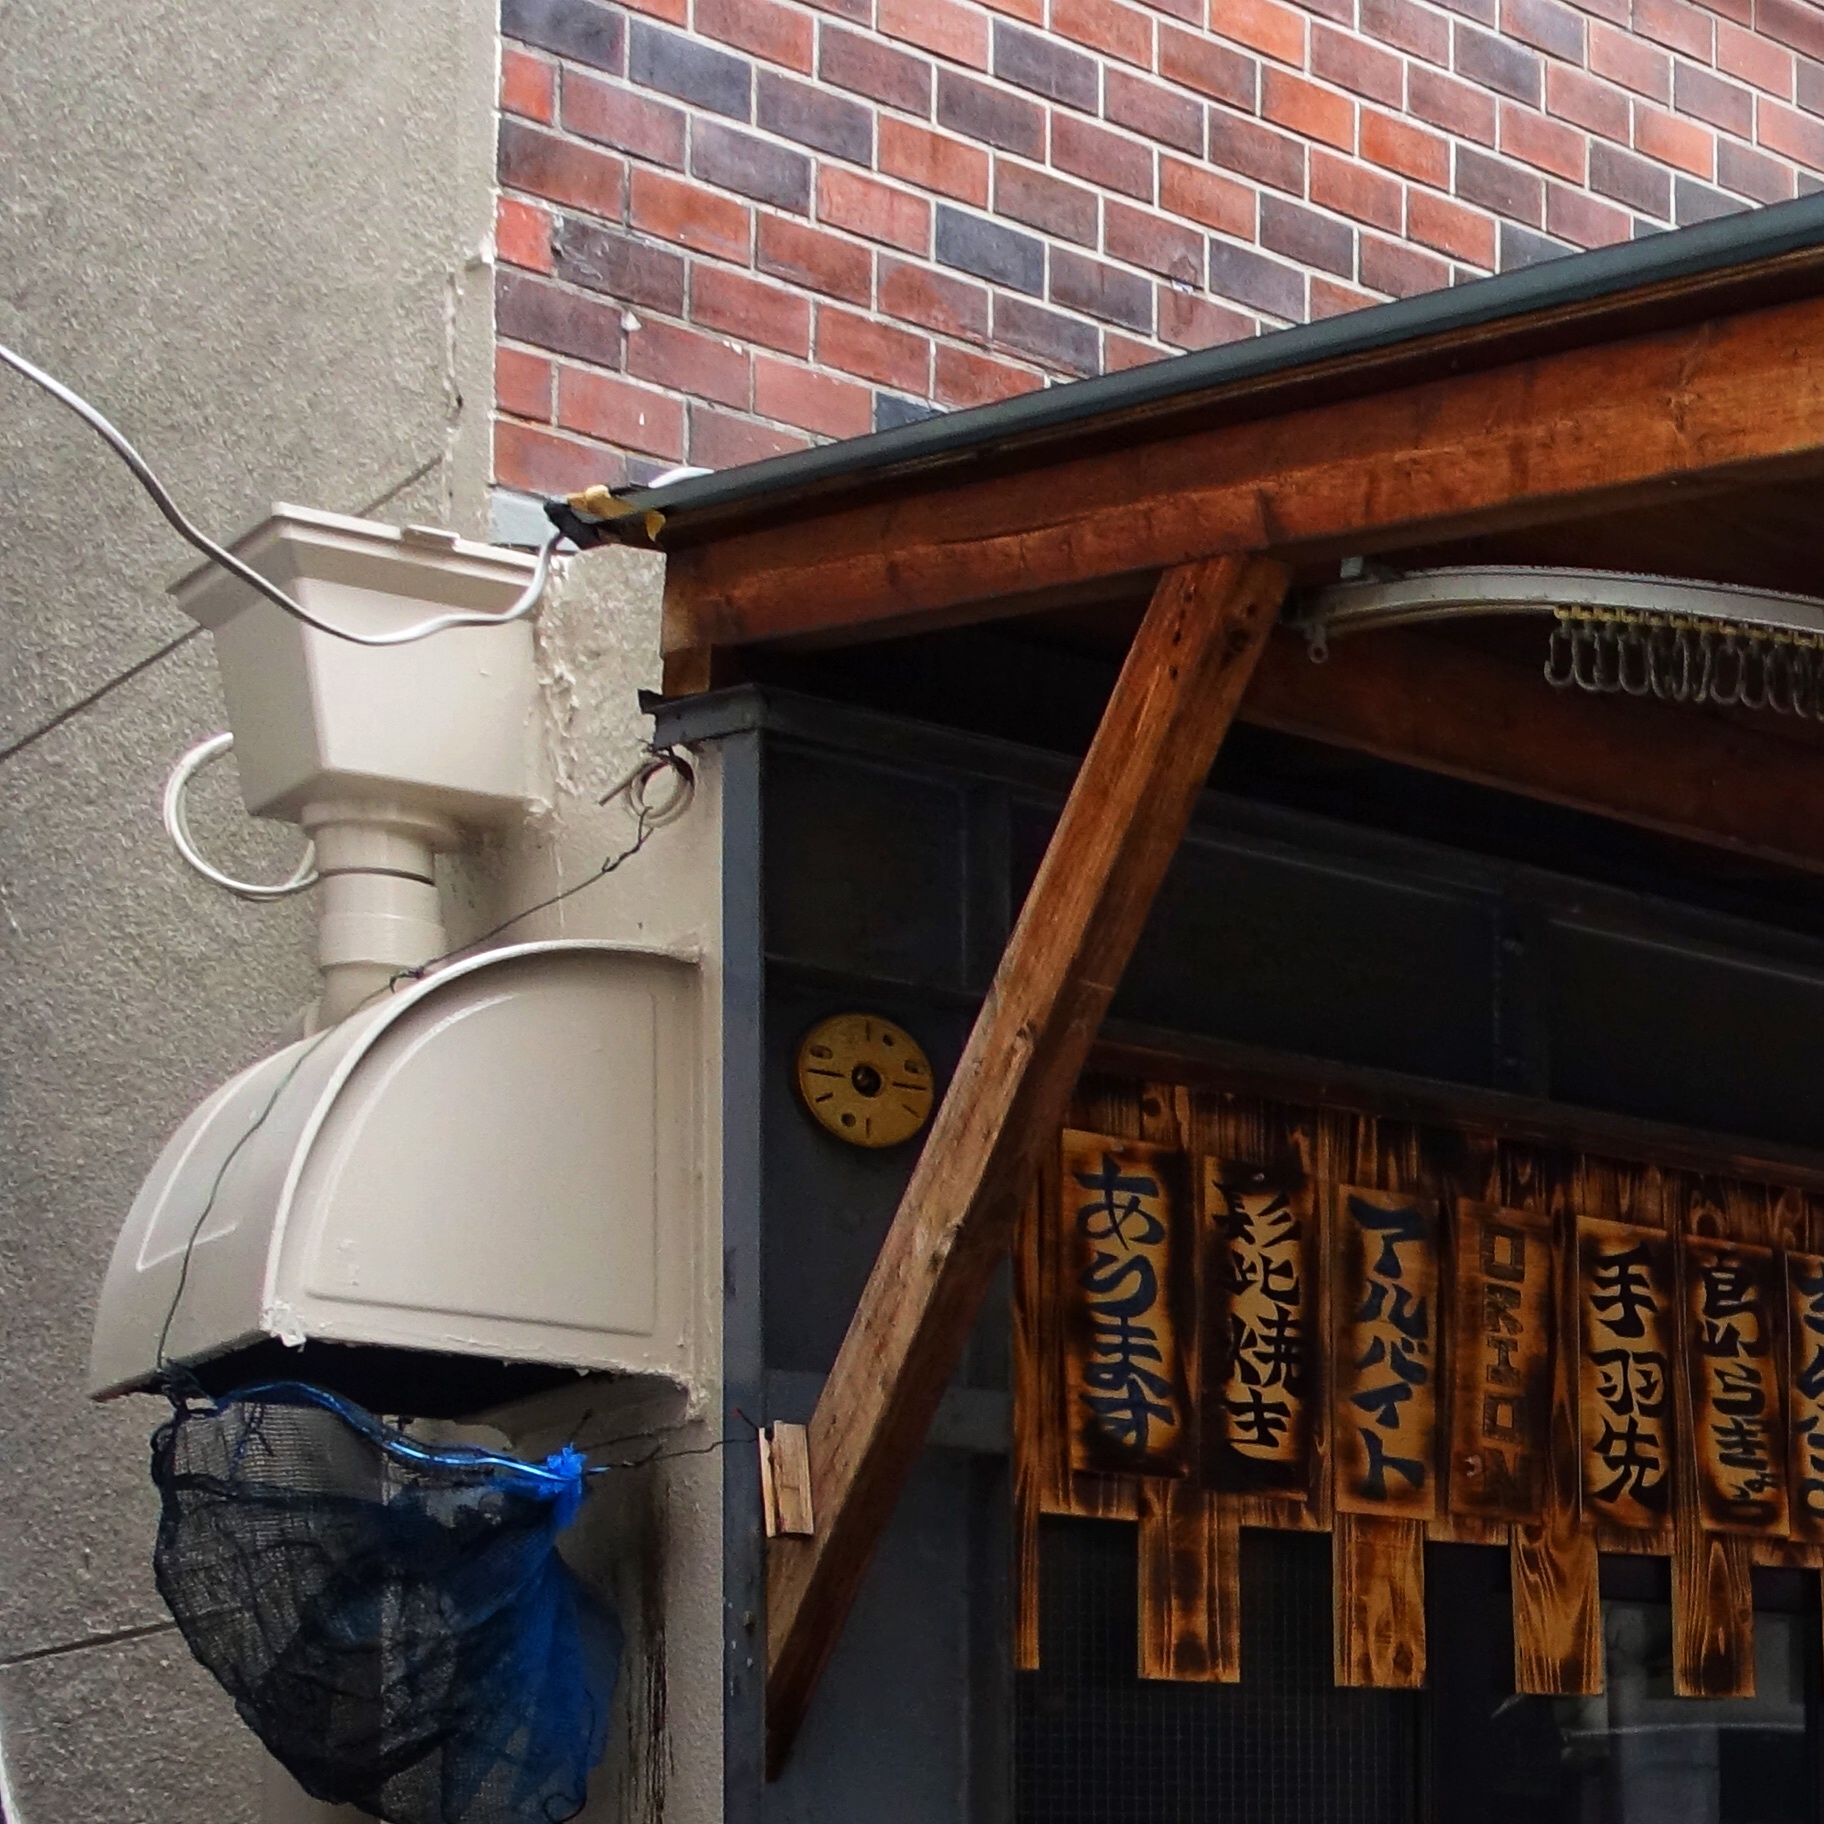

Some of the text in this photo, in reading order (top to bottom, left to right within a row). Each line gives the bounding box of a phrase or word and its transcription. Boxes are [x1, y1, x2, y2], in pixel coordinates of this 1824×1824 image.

[1073, 1155, 1176, 1451] あります
[1347, 1202, 1430, 1498] アルバイト
[1588, 1243, 1669, 1501] 手羽先
